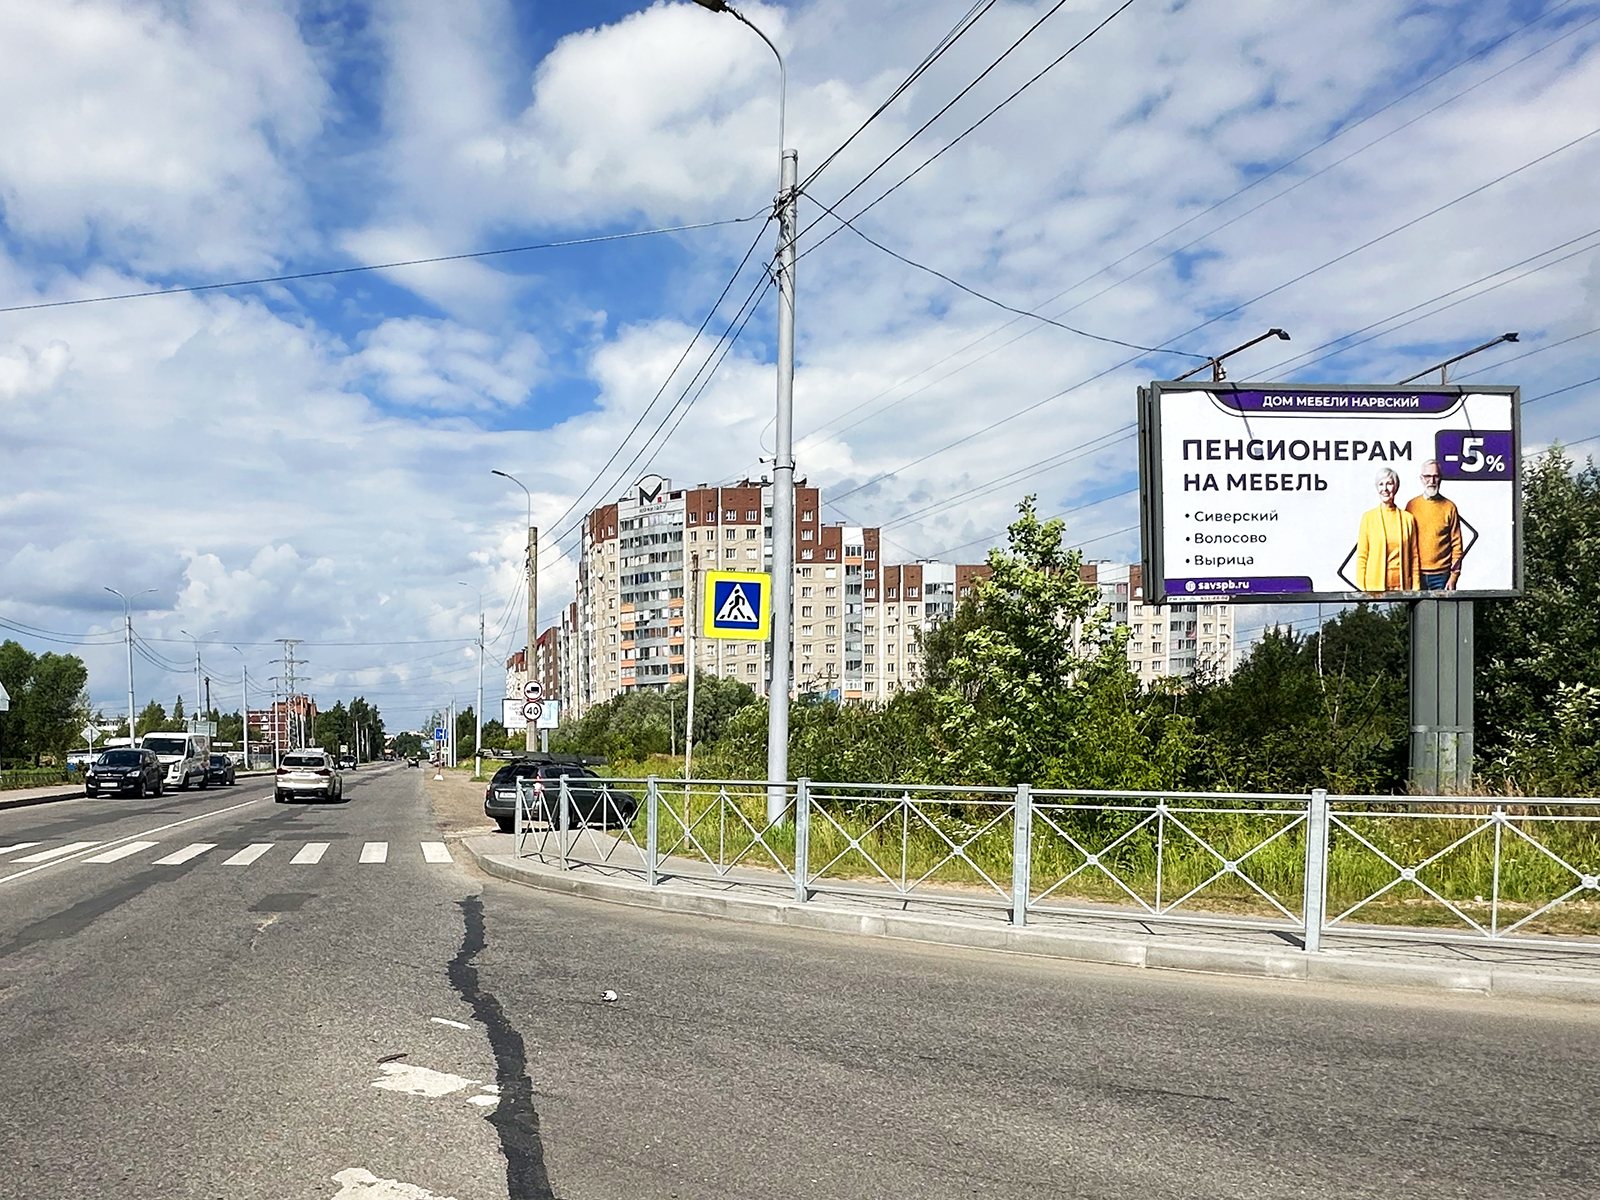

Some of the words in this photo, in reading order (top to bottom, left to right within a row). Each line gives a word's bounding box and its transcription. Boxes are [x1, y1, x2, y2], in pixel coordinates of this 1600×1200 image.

[1262, 395, 1293, 408] ДОМ
[1296, 396, 1348, 407] МЕБЕЛИ
[1351, 395, 1419, 408] НАРВСКИЙ
[1182, 439, 1412, 461] ПЕНСИОНЕРАМ
[1444, 437, 1505, 473] -5%
[1183, 473, 1219, 491] НА
[1226, 473, 1328, 491] МЕБЕЛЬ
[1194, 509, 1278, 524] Сиверский
[1194, 532, 1267, 544] Волосово
[1194, 554, 1254, 567] Вырица
[1198, 580, 1250, 593] savspb.ru
[526, 706, 539, 715] 40
